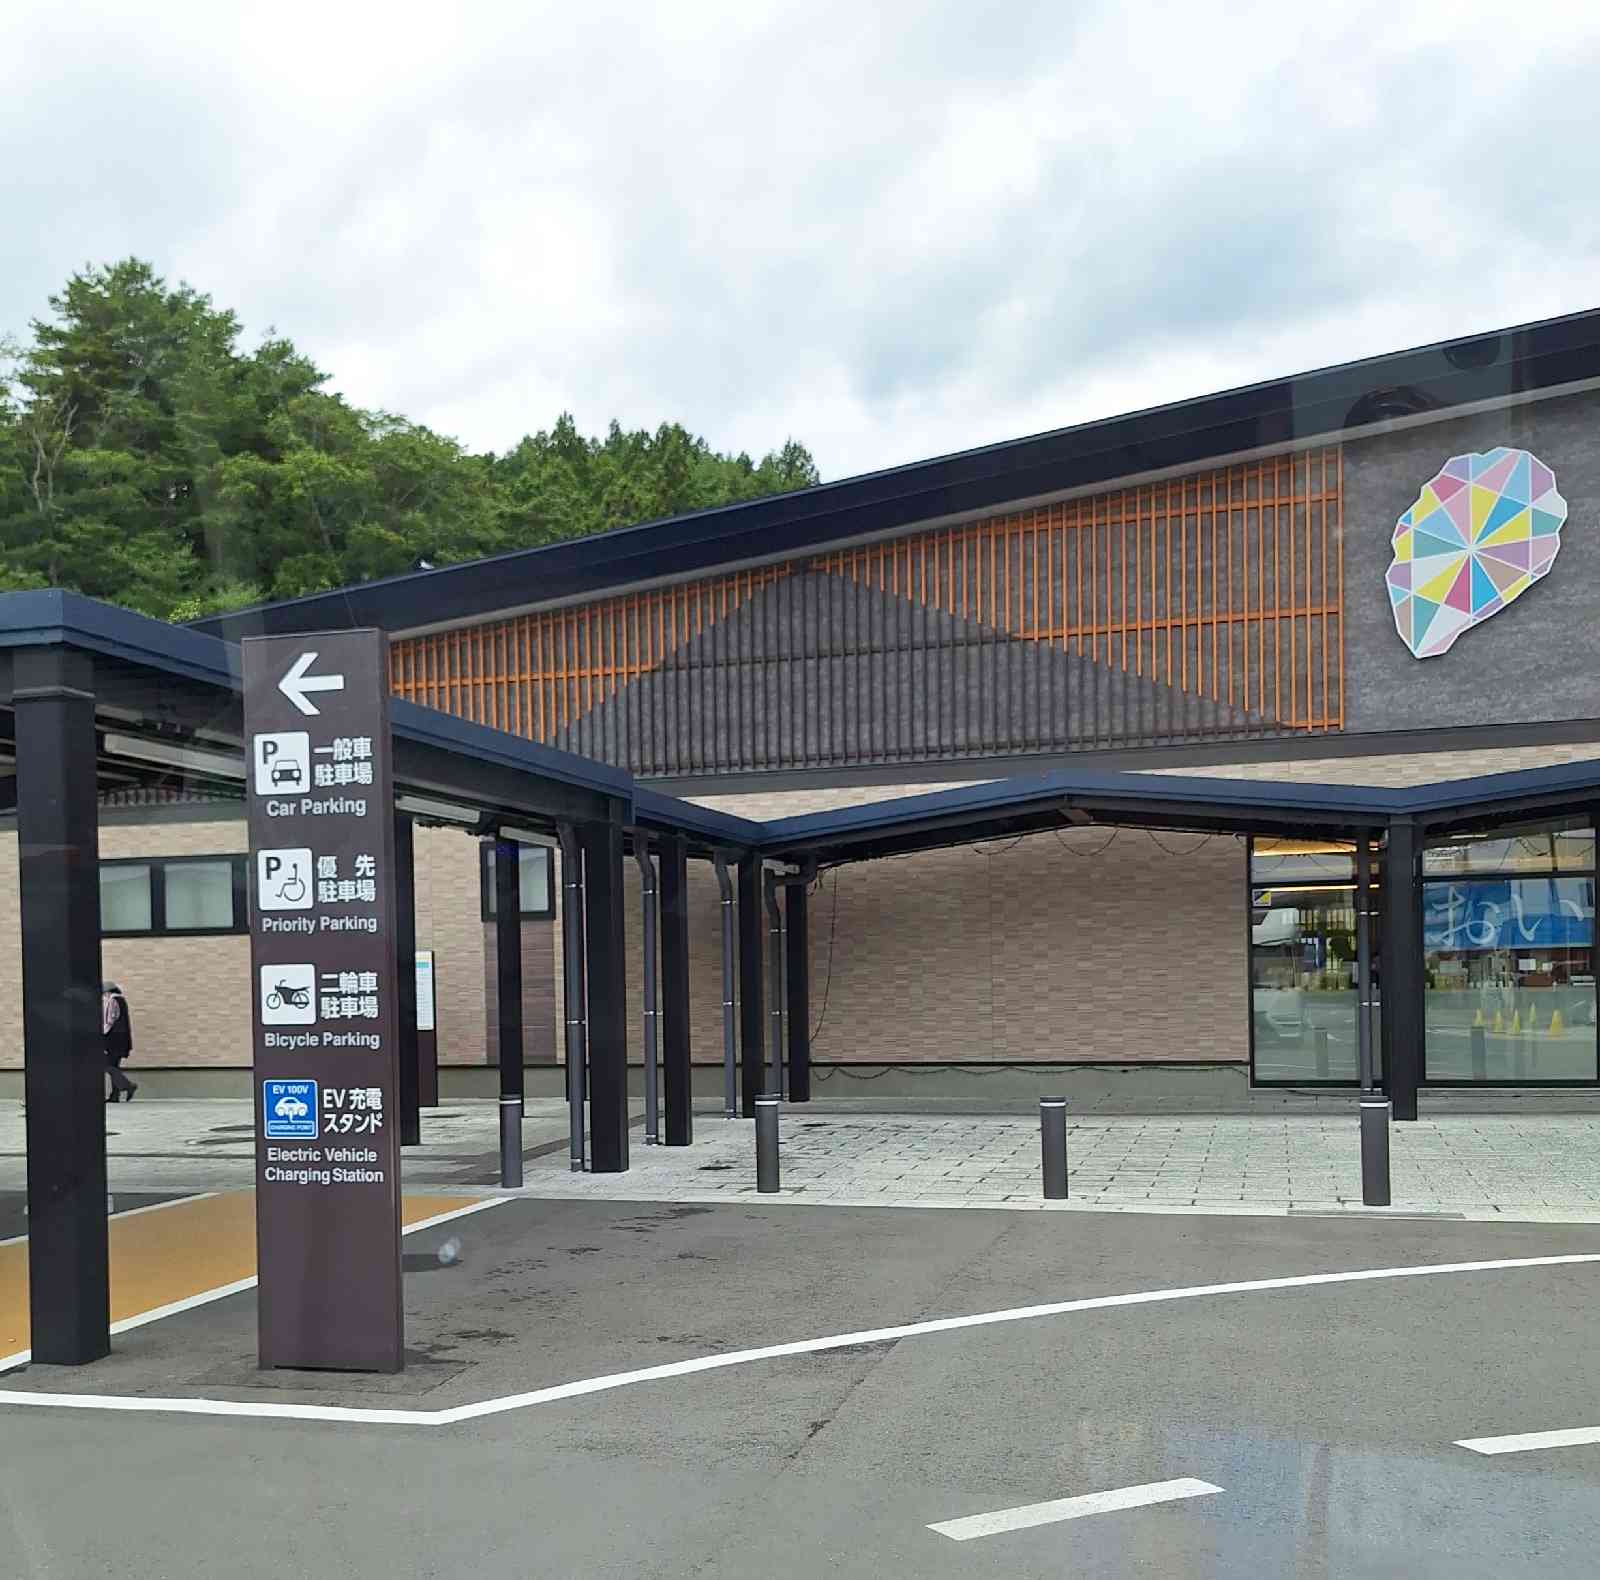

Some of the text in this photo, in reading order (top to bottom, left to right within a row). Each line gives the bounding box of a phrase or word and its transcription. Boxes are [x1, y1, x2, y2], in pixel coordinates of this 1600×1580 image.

[262, 741, 278, 765] P
[313, 736, 373, 761] 一般車
[314, 761, 373, 787] 駐車場
[266, 796, 366, 817] Car Parking
[265, 856, 281, 881] P
[318, 879, 377, 903] 駐車場
[262, 915, 377, 935] Priority Parking
[320, 971, 379, 995] 二輪車
[320, 996, 379, 1020] 駐車場
[264, 1031, 380, 1050] Bicycle Parking
[272, 1084, 286, 1095] EV
[323, 1088, 346, 1109] EV
[323, 1112, 383, 1134] スタンド
[267, 1147, 377, 1162] Electric Vehicle
[264, 1166, 384, 1185] Charging Station
